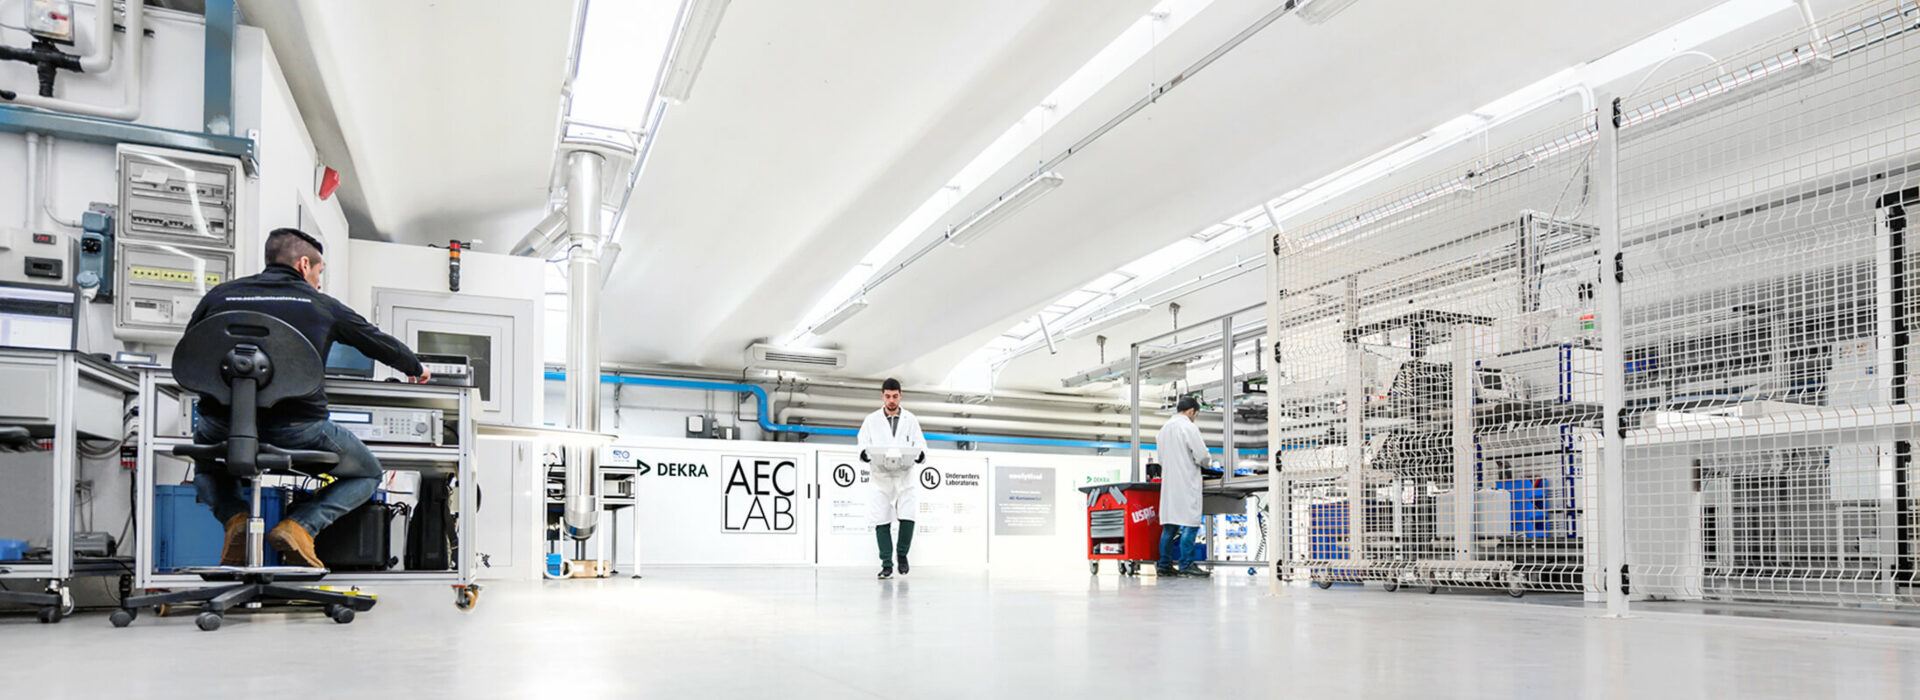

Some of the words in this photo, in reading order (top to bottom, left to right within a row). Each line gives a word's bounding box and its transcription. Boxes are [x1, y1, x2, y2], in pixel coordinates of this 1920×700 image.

[657, 462, 709, 477] DEKRA
[945, 472, 980, 480] Underwriters
[724, 459, 795, 496] AEC
[945, 479, 979, 487] Laboratories
[724, 495, 795, 531] LAB
